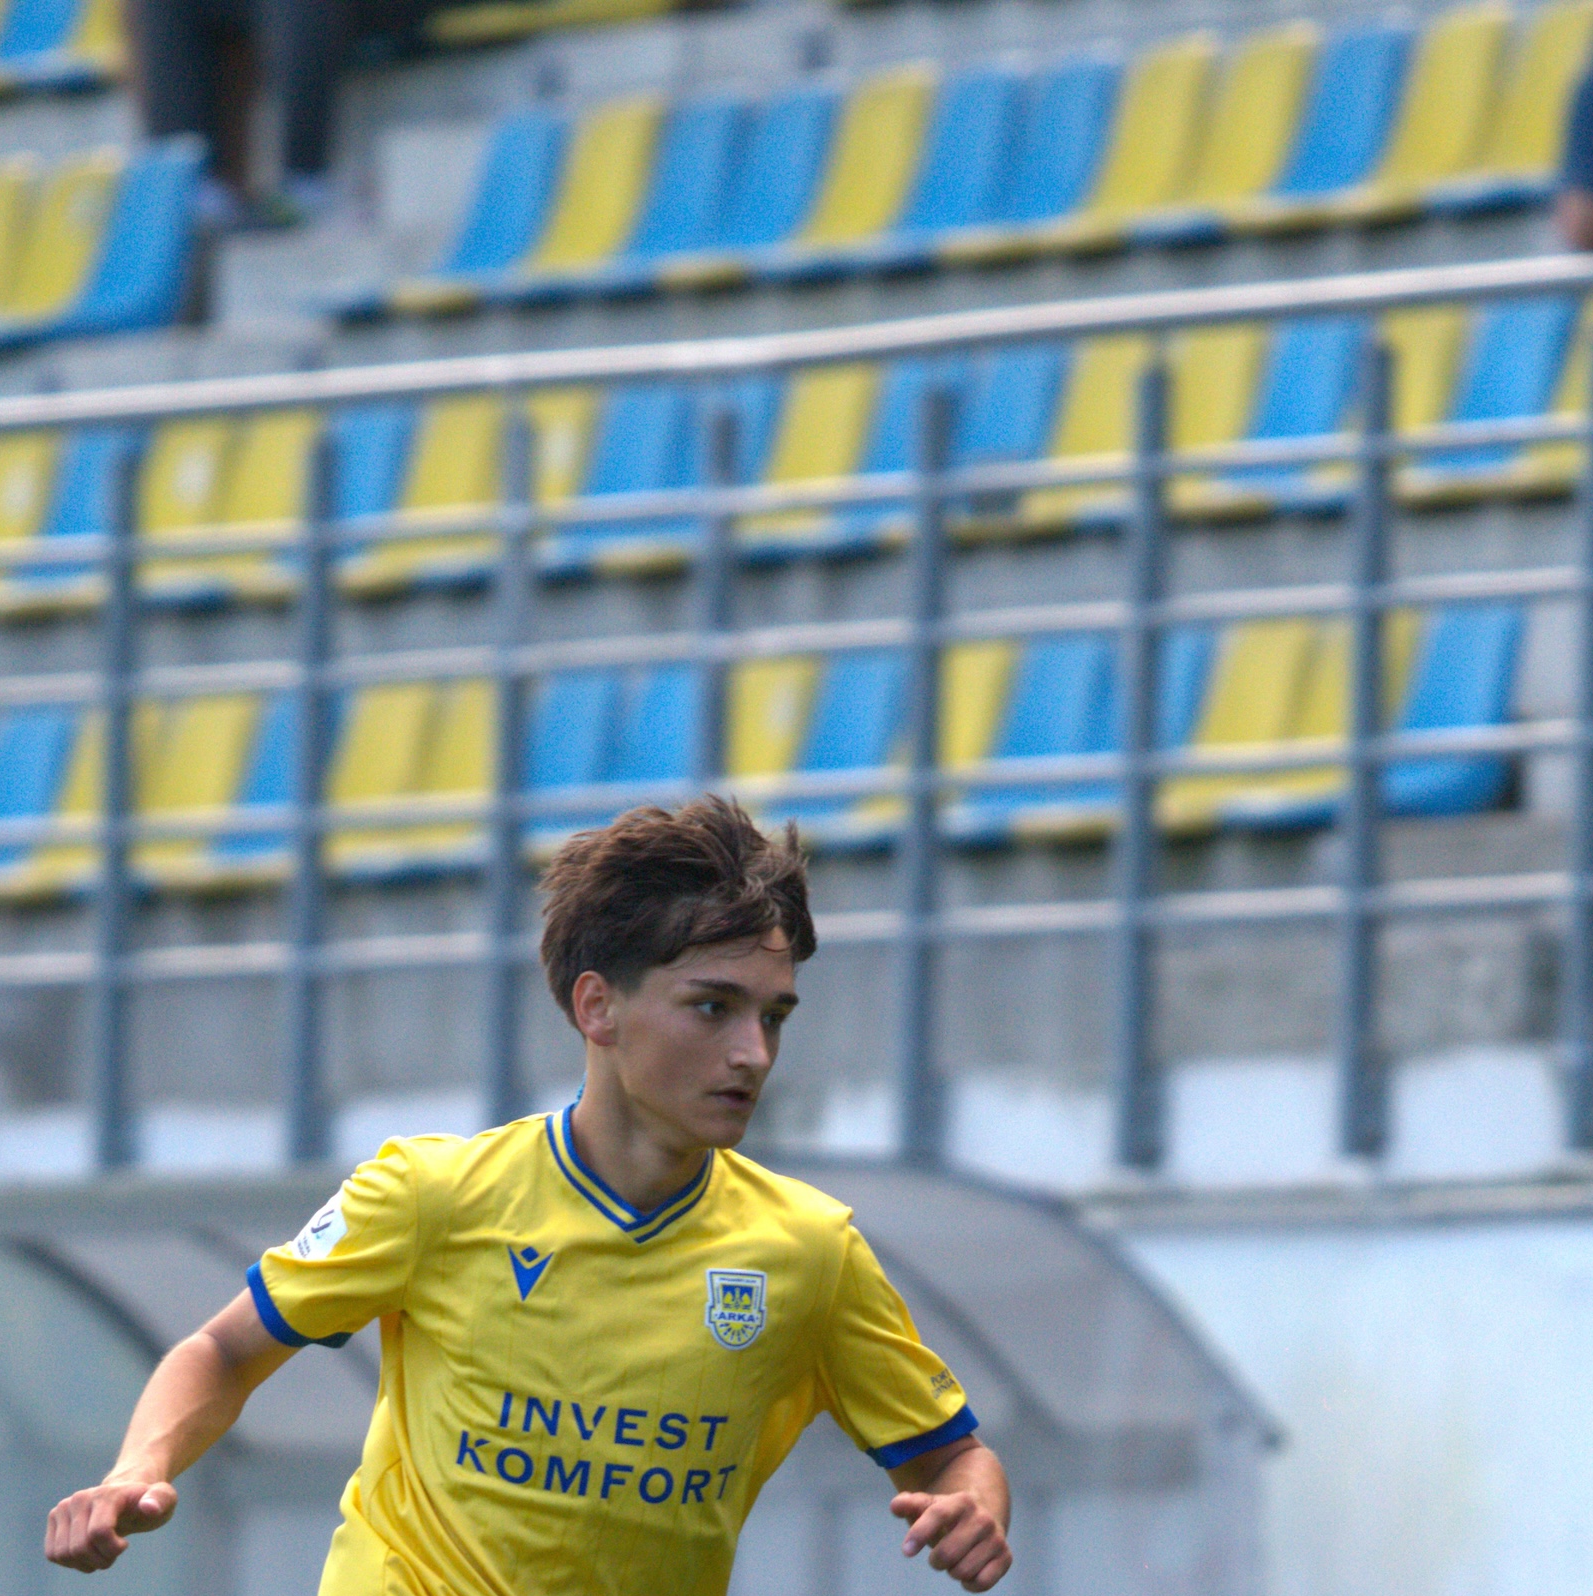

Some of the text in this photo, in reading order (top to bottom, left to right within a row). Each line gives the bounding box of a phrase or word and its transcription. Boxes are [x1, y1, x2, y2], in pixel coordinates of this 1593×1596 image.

[717, 1311, 756, 1323] ARKA
[498, 1391, 729, 1451] INVEST
[455, 1429, 737, 1505] KOMFORT
